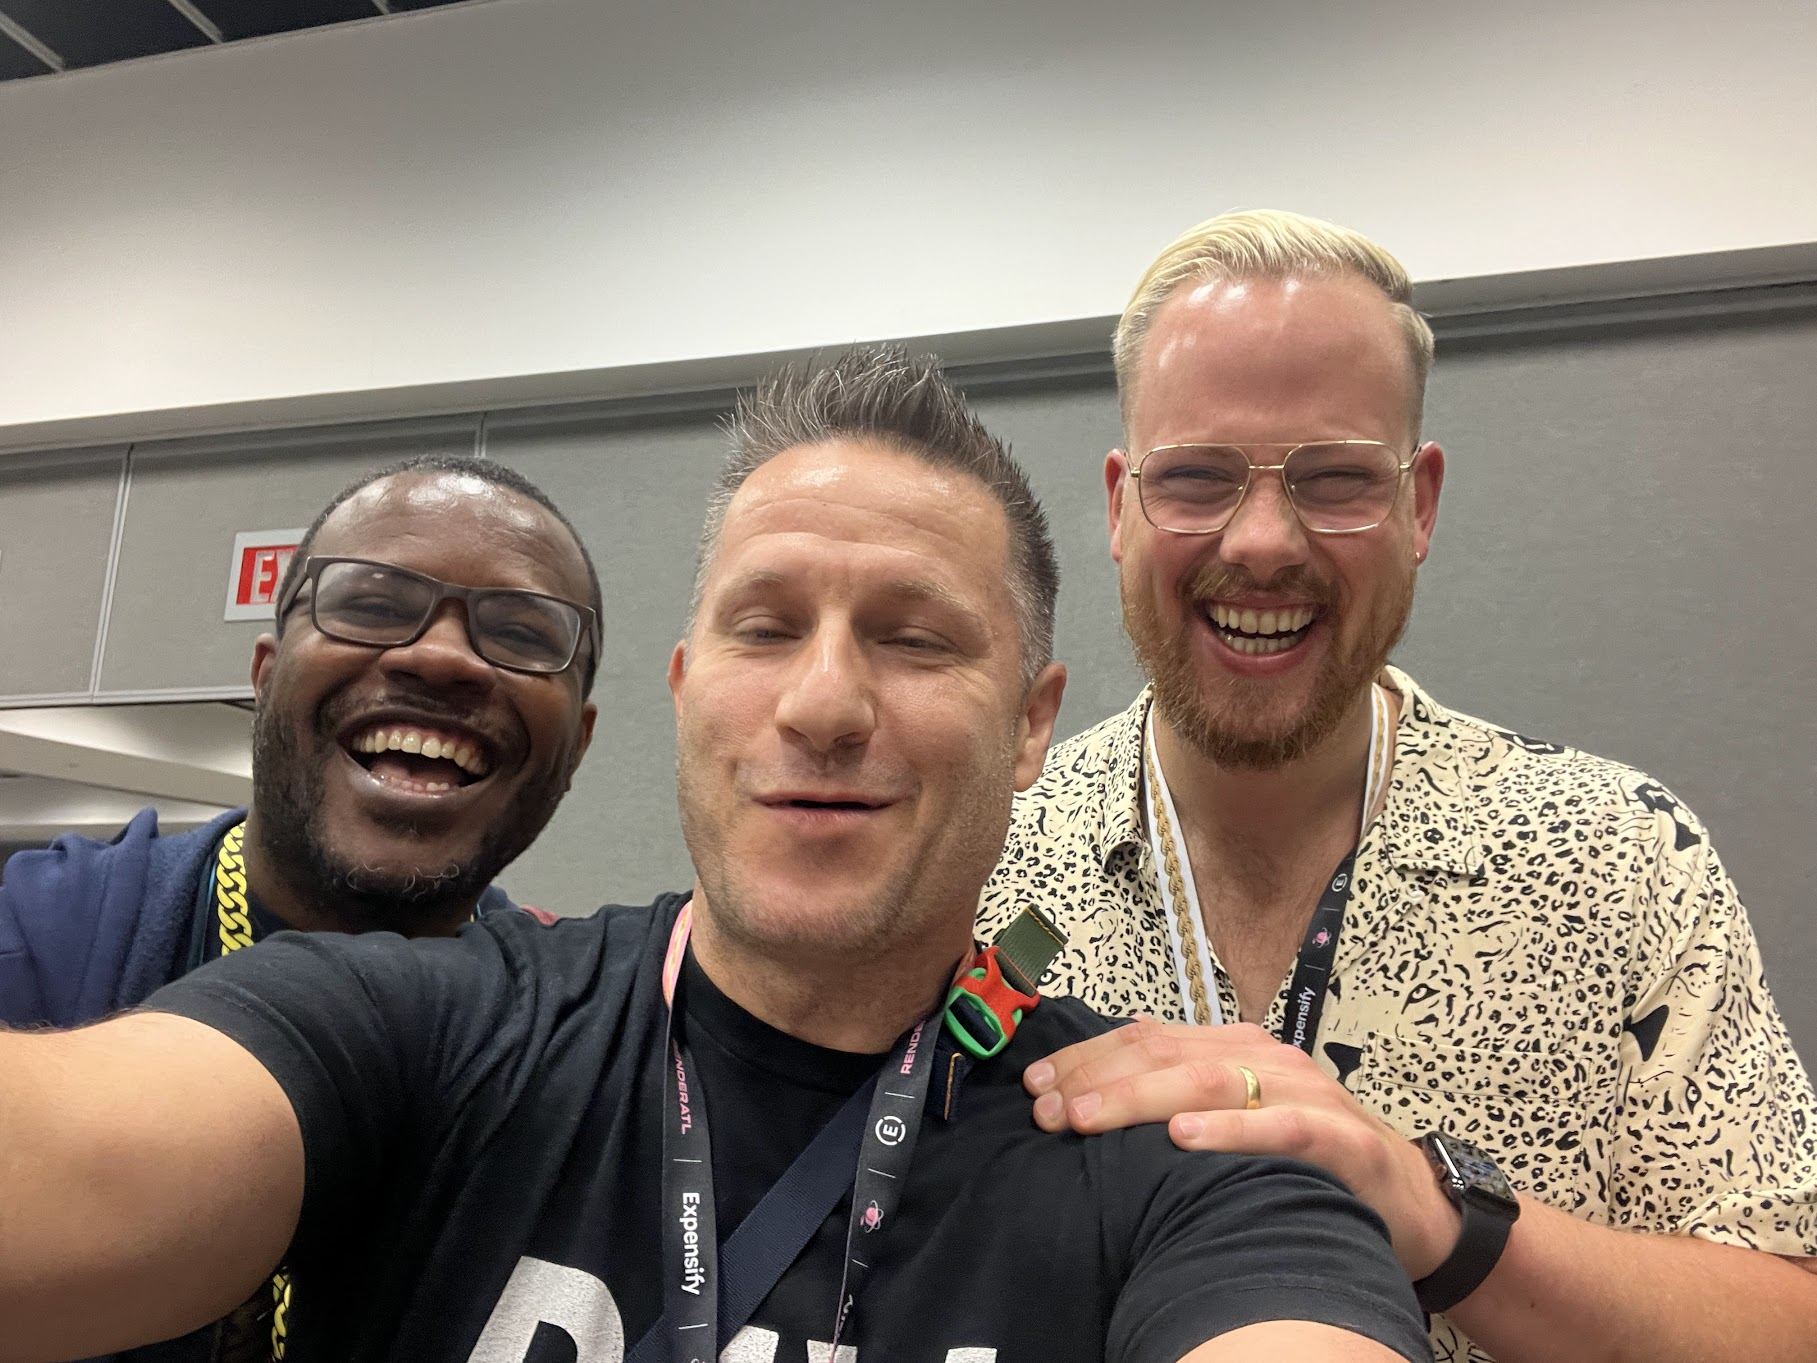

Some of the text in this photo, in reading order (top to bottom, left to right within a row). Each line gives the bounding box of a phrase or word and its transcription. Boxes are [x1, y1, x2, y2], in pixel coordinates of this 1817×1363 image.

[249, 549, 297, 604] EX
[1293, 986, 1317, 1048] xpensify
[679, 1192, 706, 1296] Expensify
